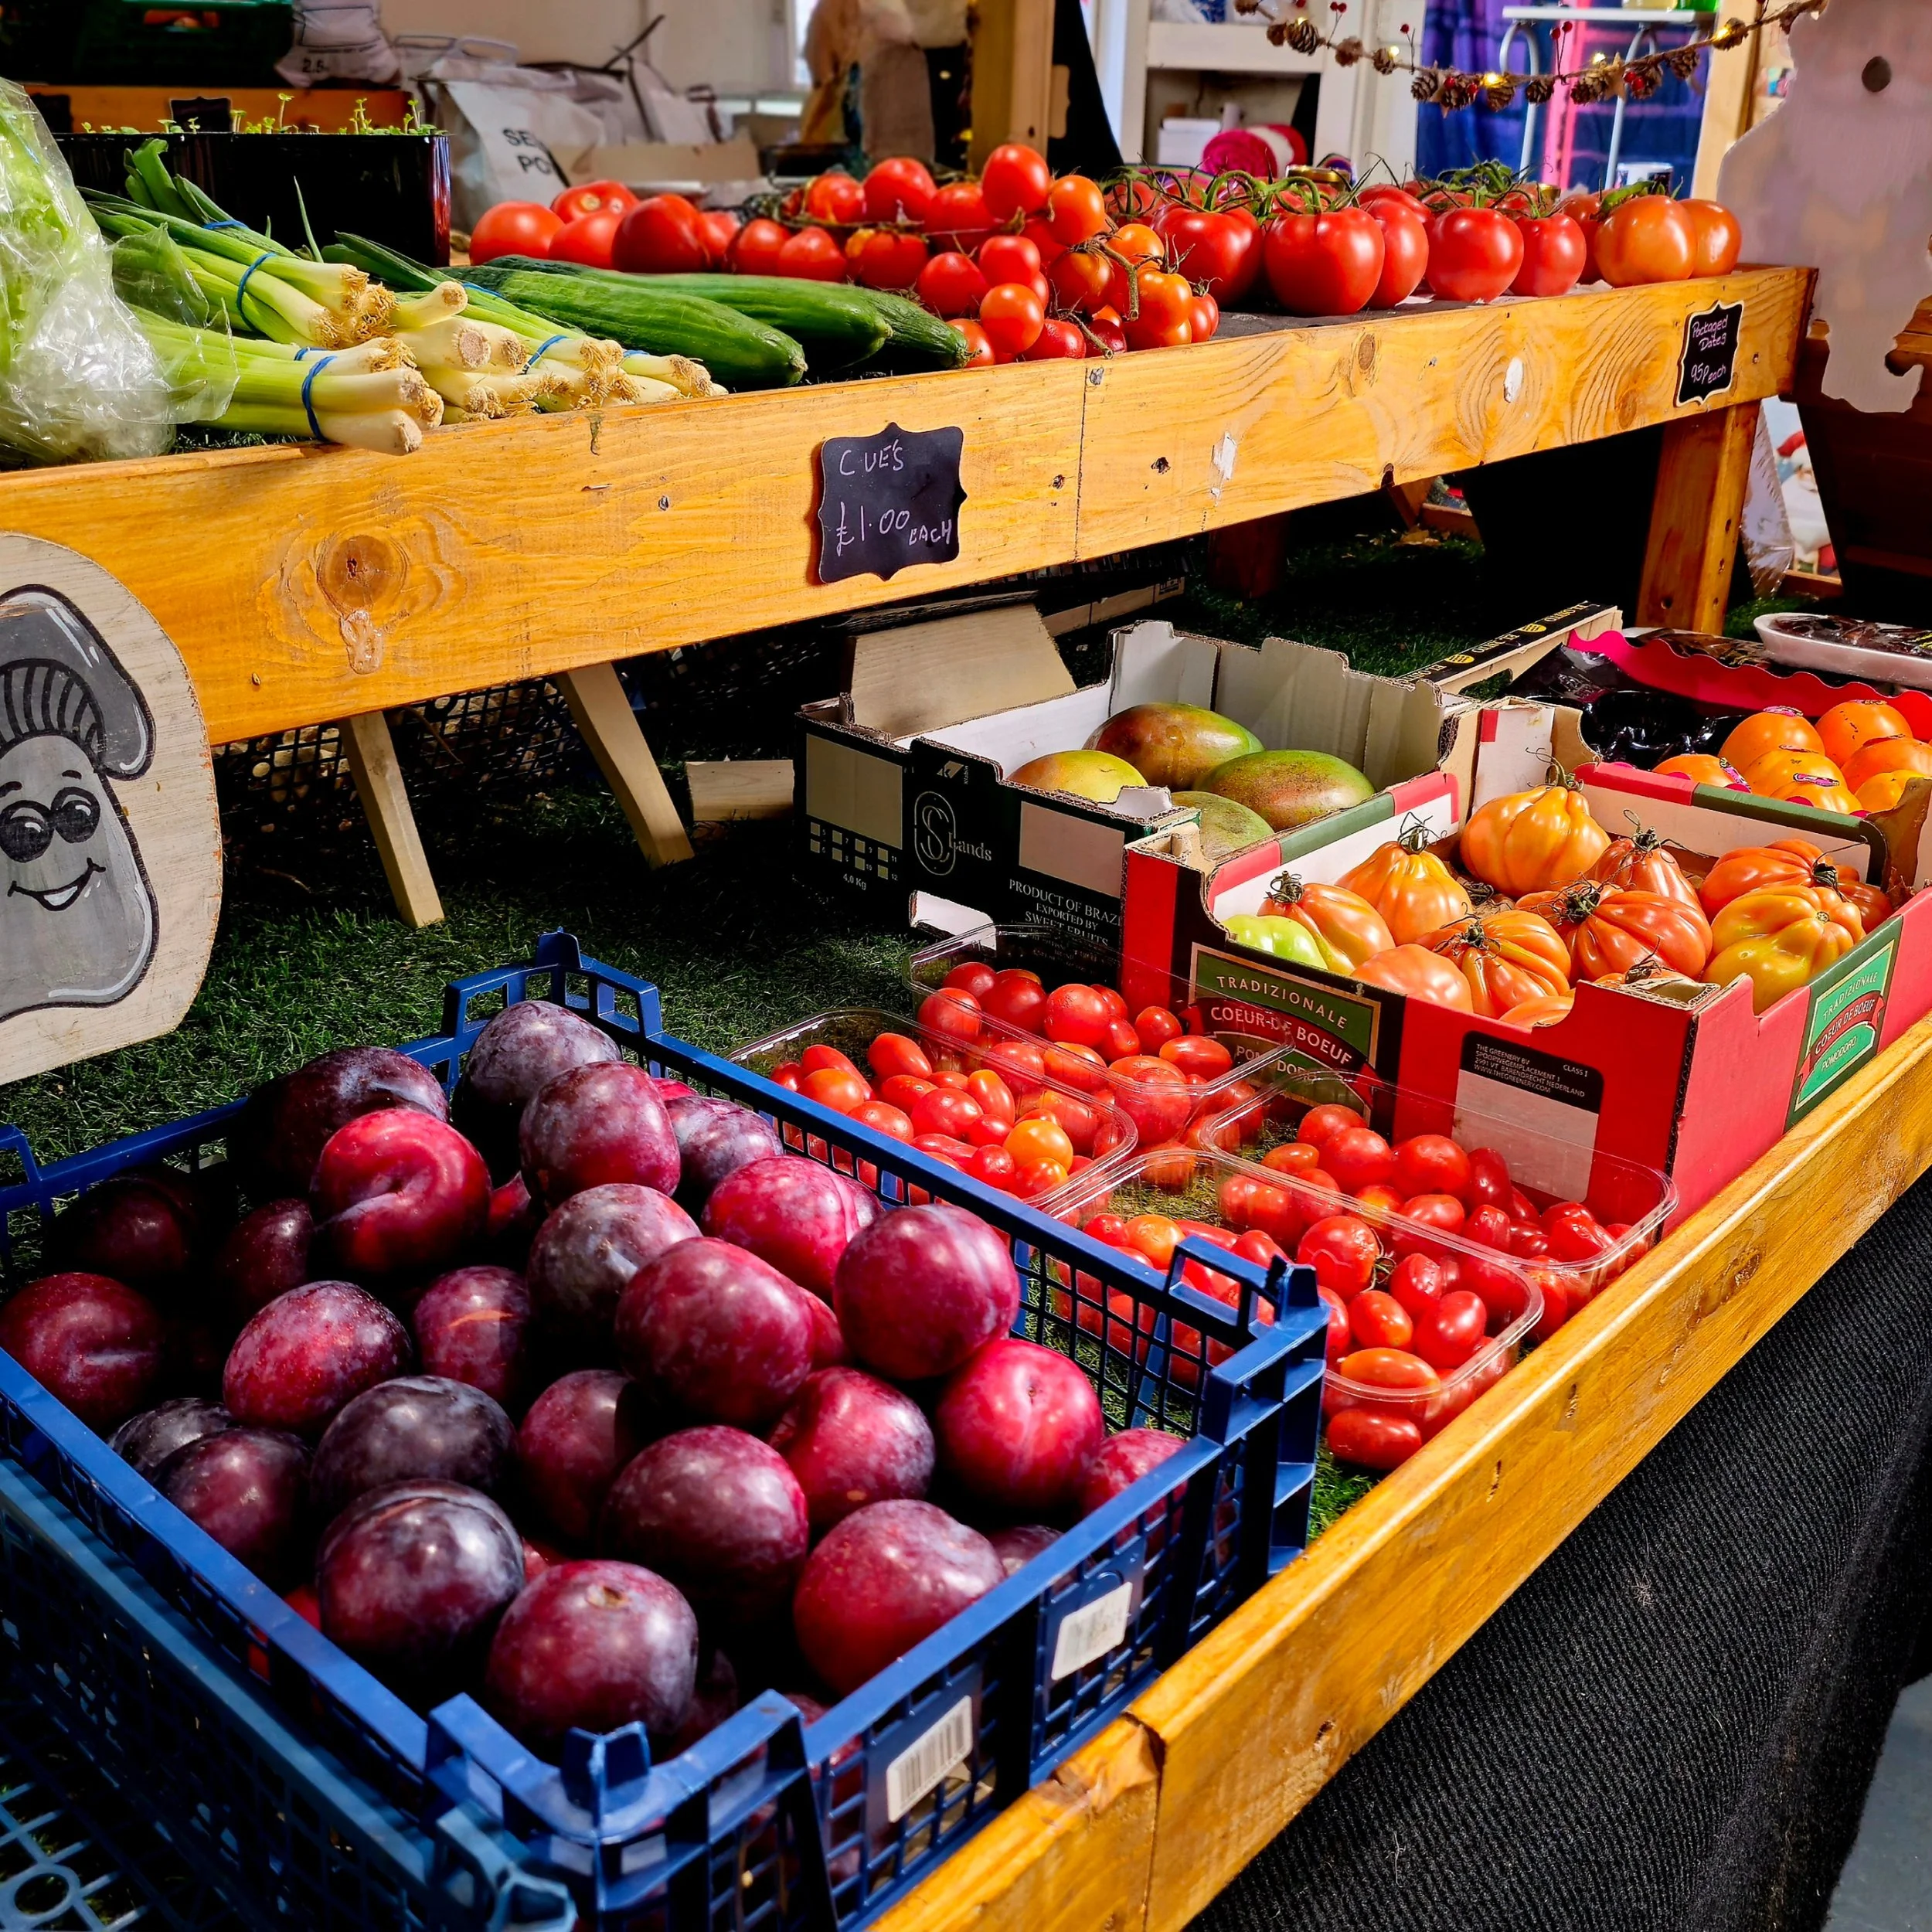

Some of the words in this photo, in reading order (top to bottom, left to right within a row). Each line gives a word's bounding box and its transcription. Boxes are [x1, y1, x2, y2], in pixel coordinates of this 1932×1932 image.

[503, 128, 538, 147] SE
[517, 155, 552, 175] PO
[1699, 332, 1727, 352] Dates
[1708, 364, 1726, 383] each
[839, 439, 904, 476] CUE'S
[835, 501, 910, 557] £1.00
[908, 519, 952, 546] EACH
[855, 878, 866, 890] Kg
[1009, 879, 1064, 906] PRODUCT
[1066, 899, 1082, 912] OF
[1084, 904, 1121, 927] BRAZI
[1036, 903, 1083, 926] EXPORTED
[1085, 920, 1098, 930] BY
[1216, 976, 1348, 1029] TRADIZIONALE
[1823, 971, 1878, 1021] TRADIZIONALE
[1211, 1007, 1265, 1027] COEUR
[1297, 1026, 1352, 1064] BOEUF
[1815, 1017, 1842, 1055] COEUR
[1843, 1009, 1855, 1025] DE
[1853, 999, 1875, 1018] BOEUF
[1476, 1043, 1488, 1053] THE
[1489, 1048, 1521, 1061] GREENERY
[1821, 1036, 1858, 1072] POMODORO
[1501, 1066, 1546, 1084] BARENDRECHT
[1546, 1080, 1585, 1097] NEDERLAND
[1563, 1064, 1583, 1076] CLASS
